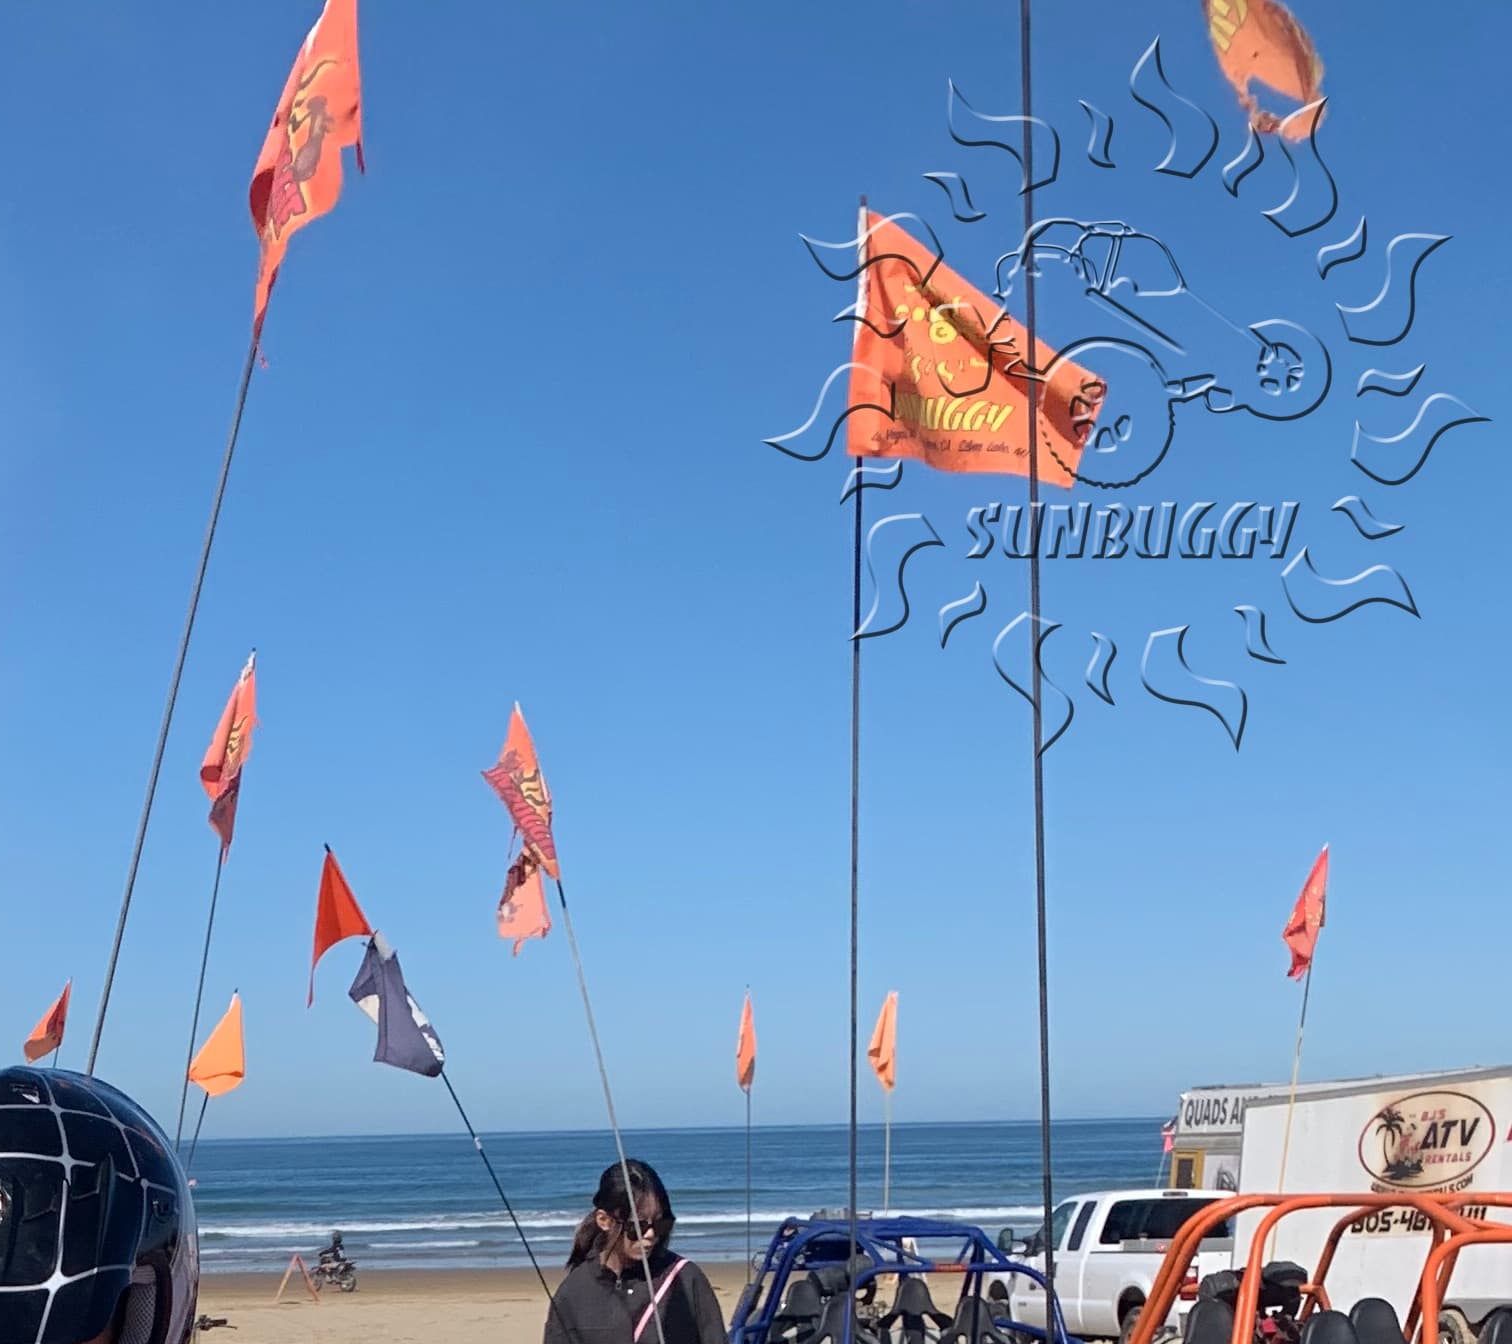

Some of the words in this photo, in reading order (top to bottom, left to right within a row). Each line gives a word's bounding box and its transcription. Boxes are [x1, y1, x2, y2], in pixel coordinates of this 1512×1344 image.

[1185, 1098, 1228, 1128] QUADS
[1420, 1117, 1480, 1150] ATV
[1424, 1152, 1472, 1165] RENTALS
